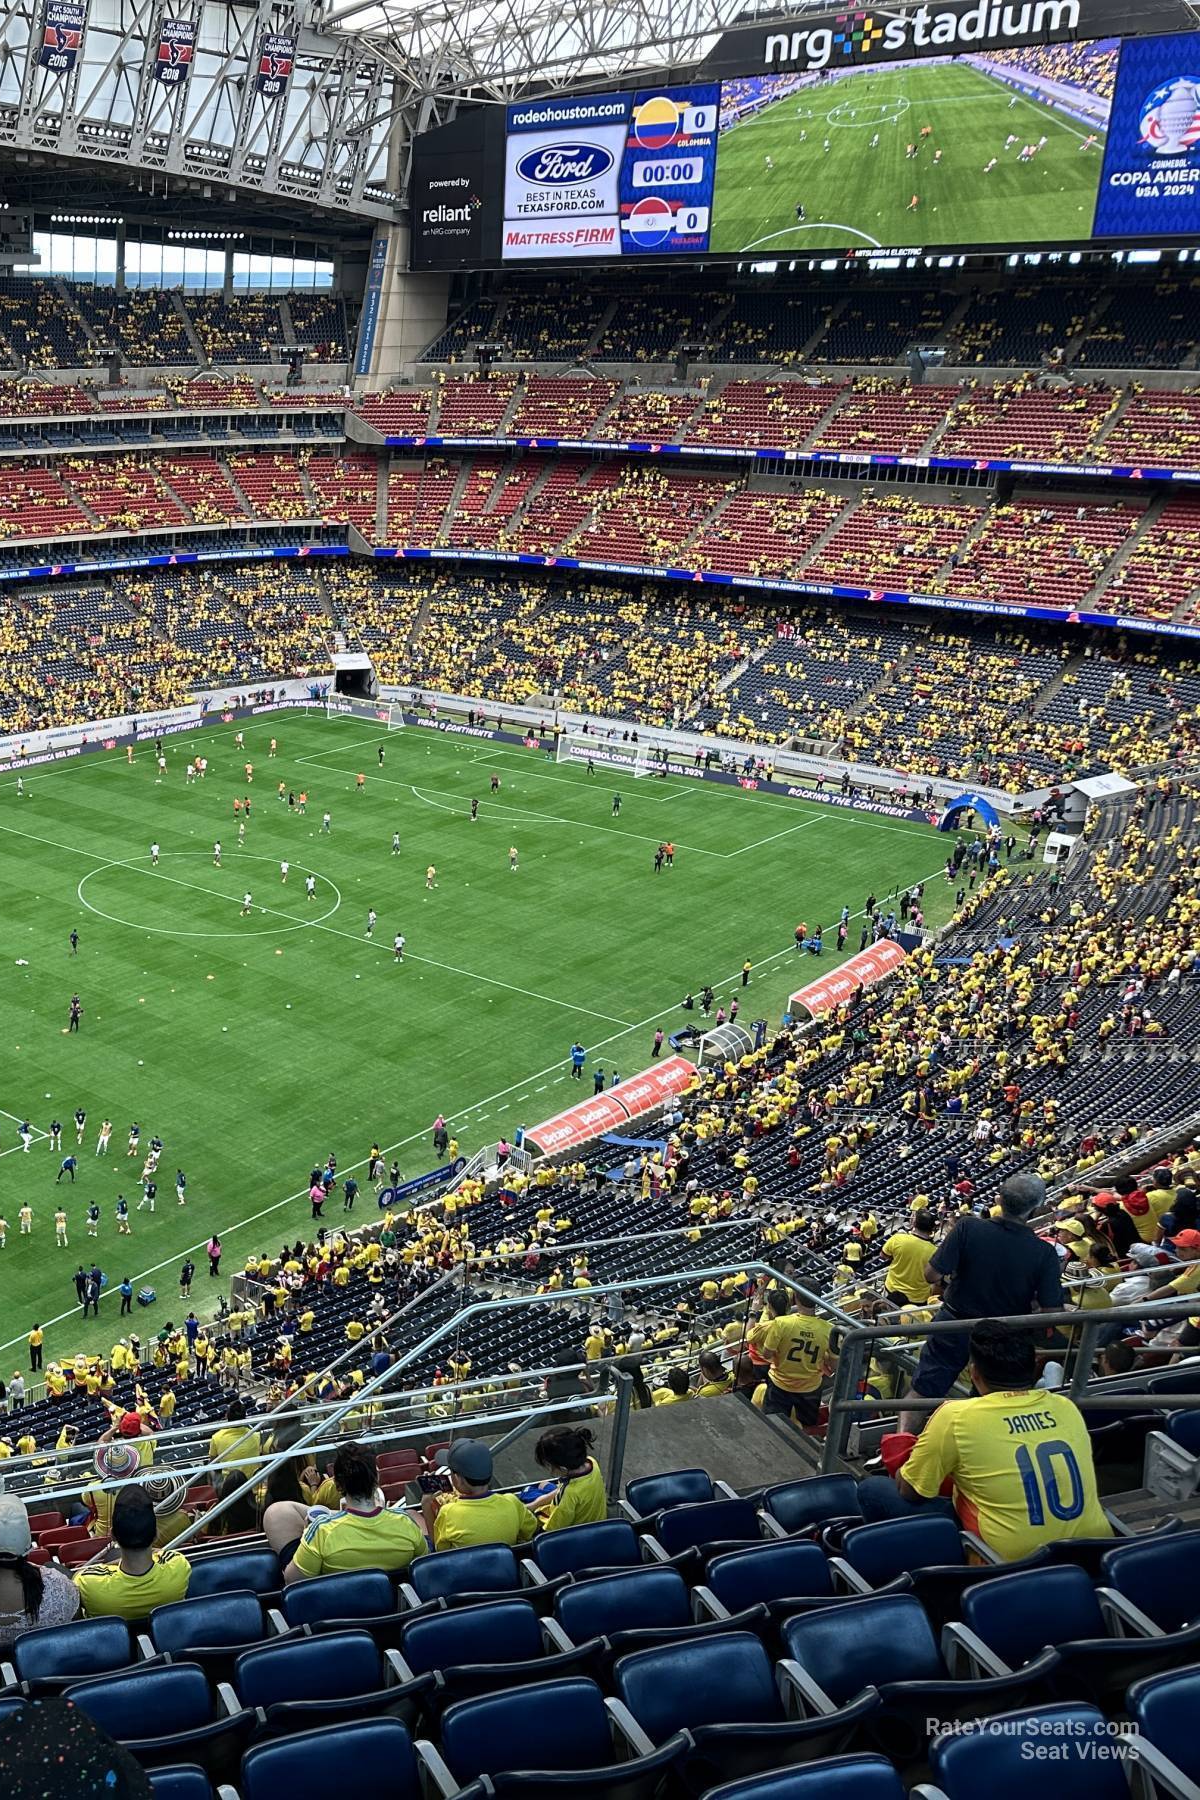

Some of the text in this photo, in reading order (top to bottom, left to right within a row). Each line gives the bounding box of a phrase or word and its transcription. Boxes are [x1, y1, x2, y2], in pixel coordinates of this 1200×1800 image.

[62, 6, 80, 16] SOUTH
[48, 12, 82, 25] CHAMPIONS
[162, 28, 194, 40] CHAMPIONS
[176, 24, 192, 32] SOUTH
[764, 0, 1081, 69] nrg stadium
[264, 44, 293, 54] CHAMPIONS
[48, 54, 68, 68] 2016
[161, 68, 180, 80] 2018
[263, 80, 280, 92] 2019
[512, 101, 625, 126] rodeohouston.com
[694, 112, 706, 128] 0
[677, 138, 712, 148] COLOMBIA
[535, 149, 592, 179] Ford
[1152, 158, 1188, 169] CONMEBOL
[642, 164, 694, 182] 00:00
[1110, 172, 1152, 186] COPA
[429, 178, 470, 190] powered by
[1136, 184, 1194, 198] USA 2024
[526, 188, 596, 202] BEST IN TEXAS
[423, 204, 472, 222] reliant
[517, 200, 605, 214] TEXASFORD.COM
[686, 213, 698, 229] 0
[444, 228, 470, 236] company
[854, 248, 922, 257] MITSUBISHI ELECTRIC
[417, 717, 438, 730] VIBRA
[445, 724, 495, 740] CONTINENTE
[12, 758, 30, 768] COPA
[29, 754, 55, 766] AMERICA
[570, 746, 610, 762] CONMEBOL
[612, 752, 633, 764] COPA
[632, 756, 668, 770] AMERICA
[788, 786, 913, 818] ROCKING THE CONTINENT
[623, 1084, 651, 1102] Betano
[580, 1106, 610, 1124] Betano
[540, 1124, 574, 1146] Betano
[786, 1338, 820, 1364] 24
[1003, 1411, 1057, 1434] JAMES
[1014, 1440, 1084, 1526] 10
